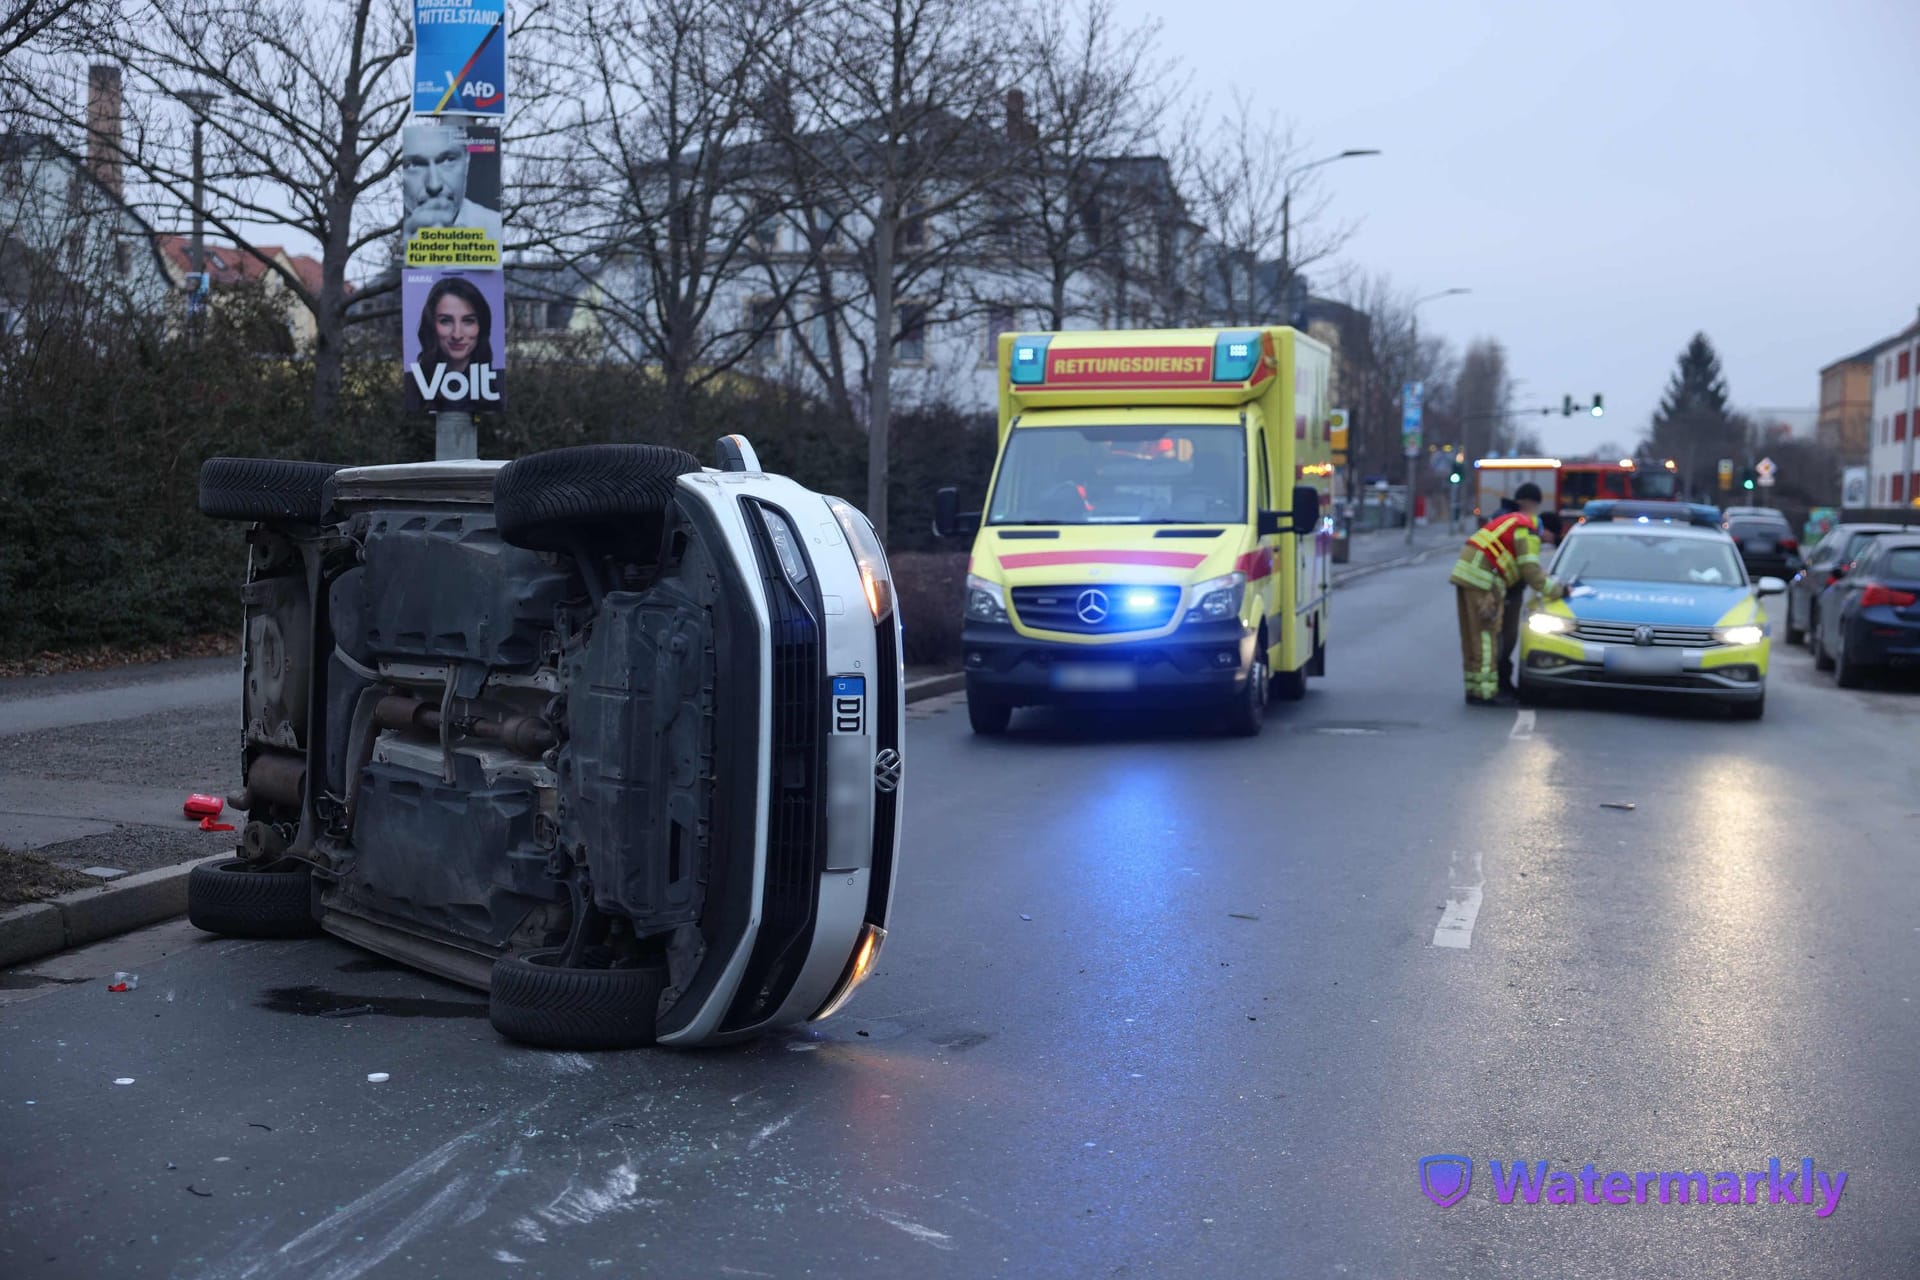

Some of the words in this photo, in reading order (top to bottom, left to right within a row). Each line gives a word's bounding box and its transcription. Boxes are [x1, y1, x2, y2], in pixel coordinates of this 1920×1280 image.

[461, 80, 496, 98] AfD
[420, 231, 484, 240] Schulden:
[410, 242, 450, 251] Kinder
[452, 242, 495, 251] haften
[409, 253, 427, 262] für
[429, 253, 453, 262] ihre
[455, 253, 497, 262] Eltern.
[1053, 356, 1206, 375] RETTUNGSDIENST
[410, 362, 501, 401] Volt
